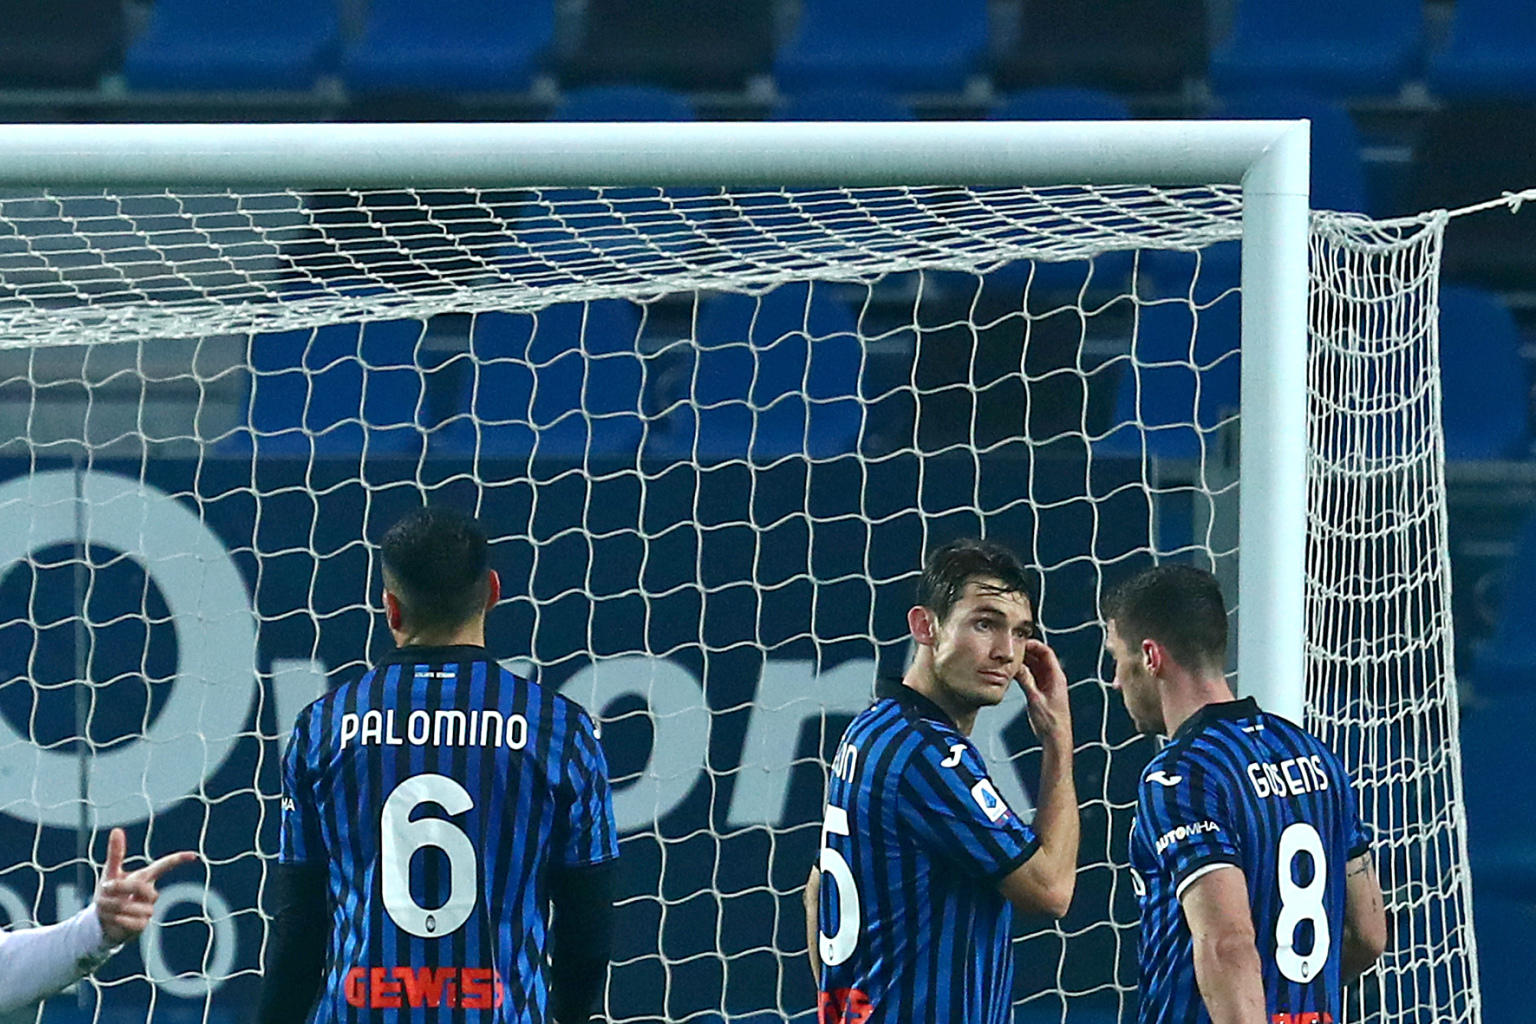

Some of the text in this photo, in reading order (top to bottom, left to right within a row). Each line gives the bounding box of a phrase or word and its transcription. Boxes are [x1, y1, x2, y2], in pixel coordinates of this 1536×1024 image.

[340, 709, 528, 750] PALOMINO
[1246, 755, 1329, 798] GOSENS
[381, 773, 475, 938] 6
[1275, 822, 1330, 984] 8
